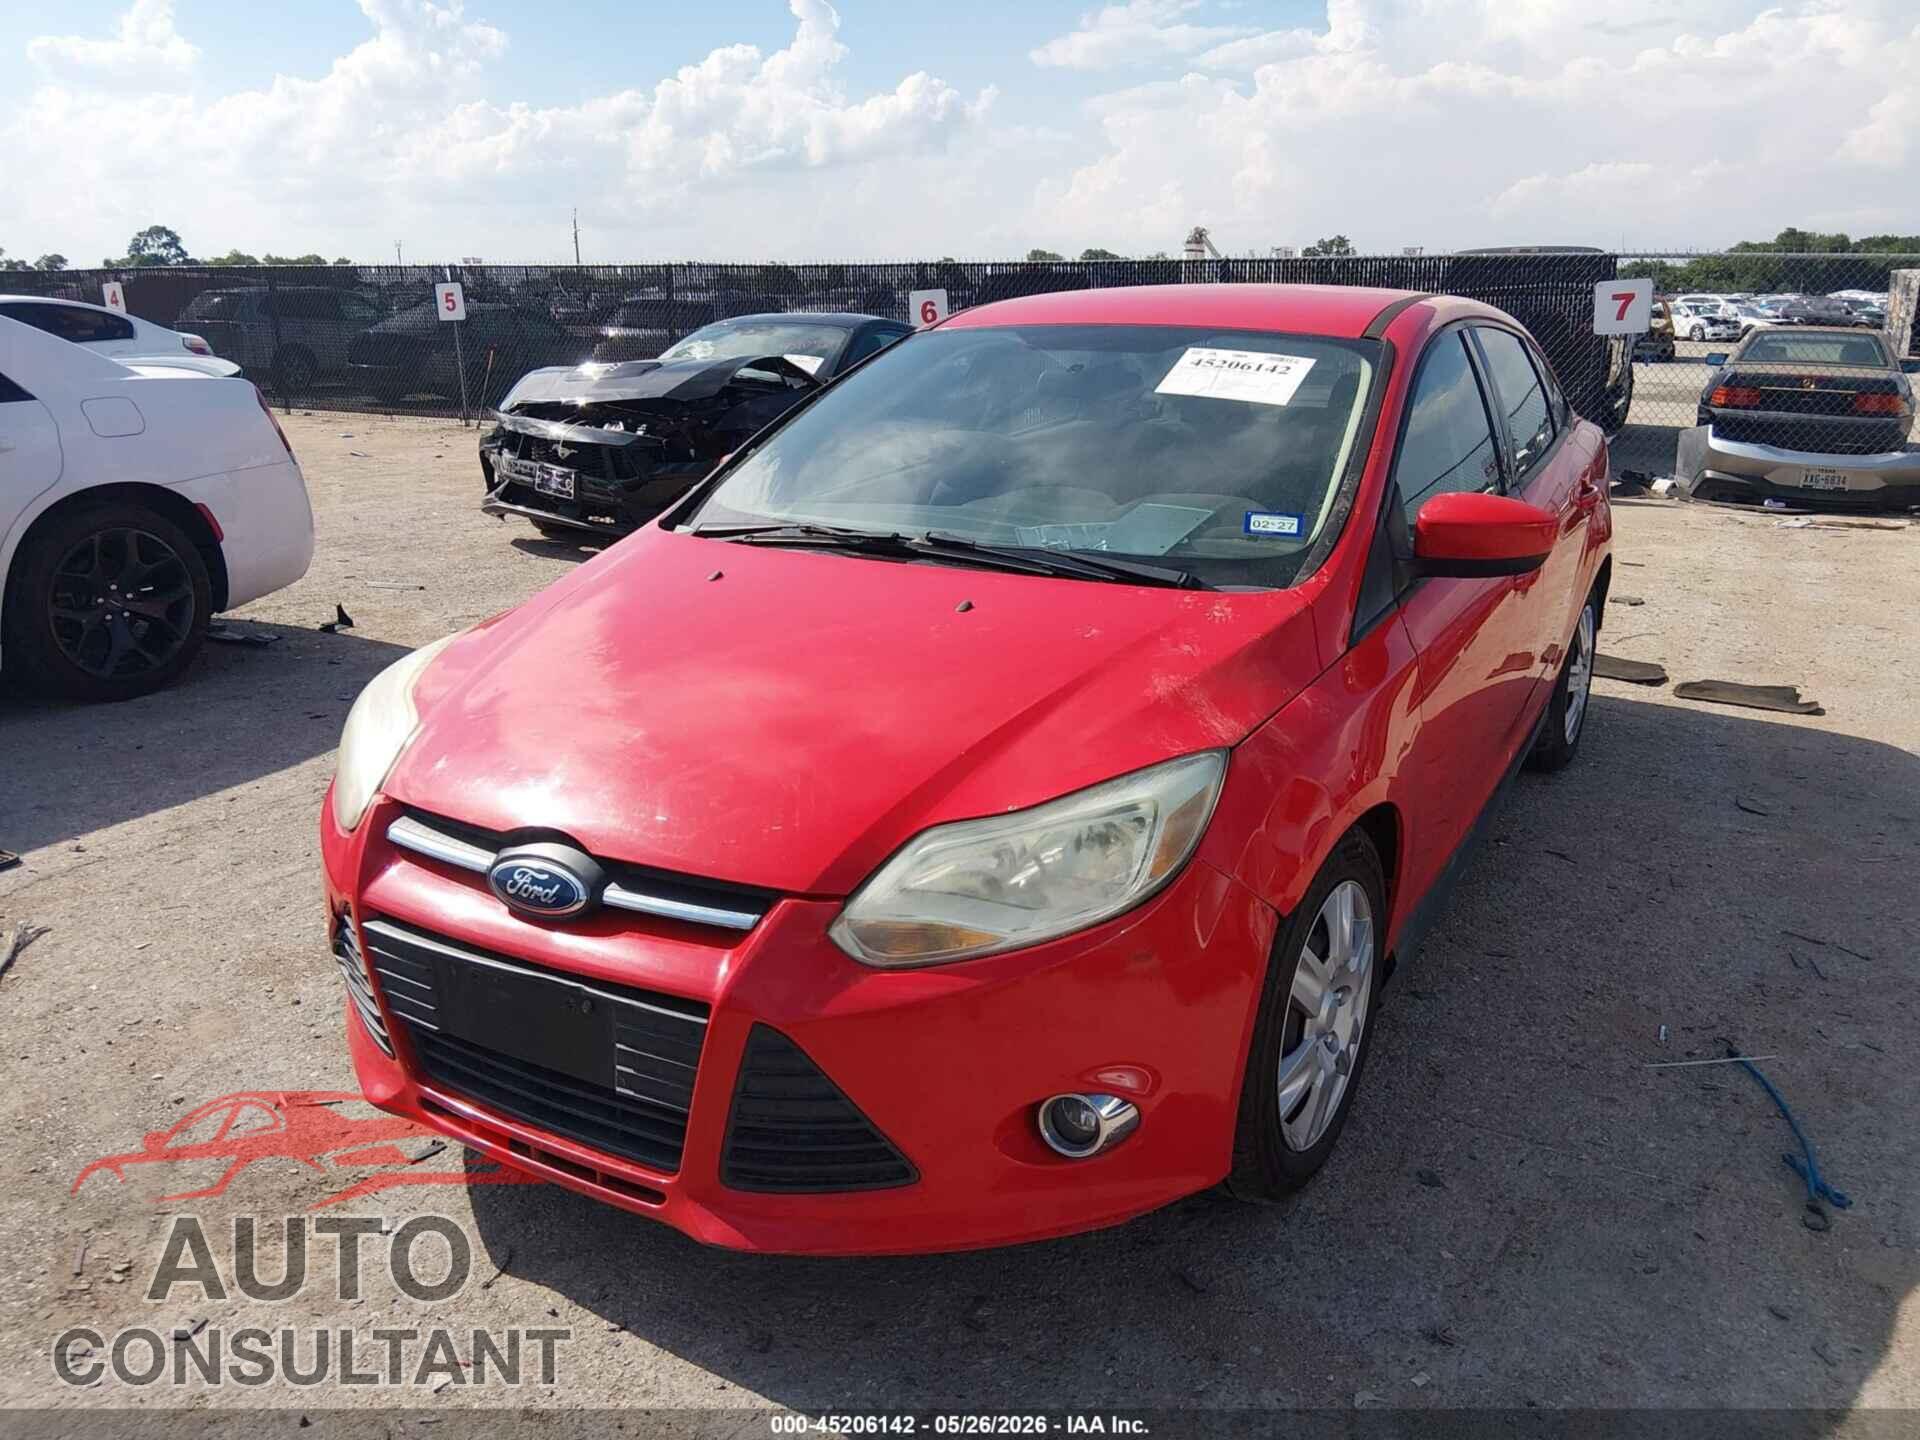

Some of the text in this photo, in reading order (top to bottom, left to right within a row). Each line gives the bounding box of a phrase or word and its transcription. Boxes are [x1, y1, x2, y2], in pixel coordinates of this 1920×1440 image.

[110, 289, 120, 305] 4
[444, 292, 456, 312] 5
[1611, 292, 1636, 321] 7
[920, 300, 938, 324] 6
[1189, 358, 1292, 375] 45206142
[1252, 519, 1296, 531] 02-27
[506, 867, 561, 903] Ford
